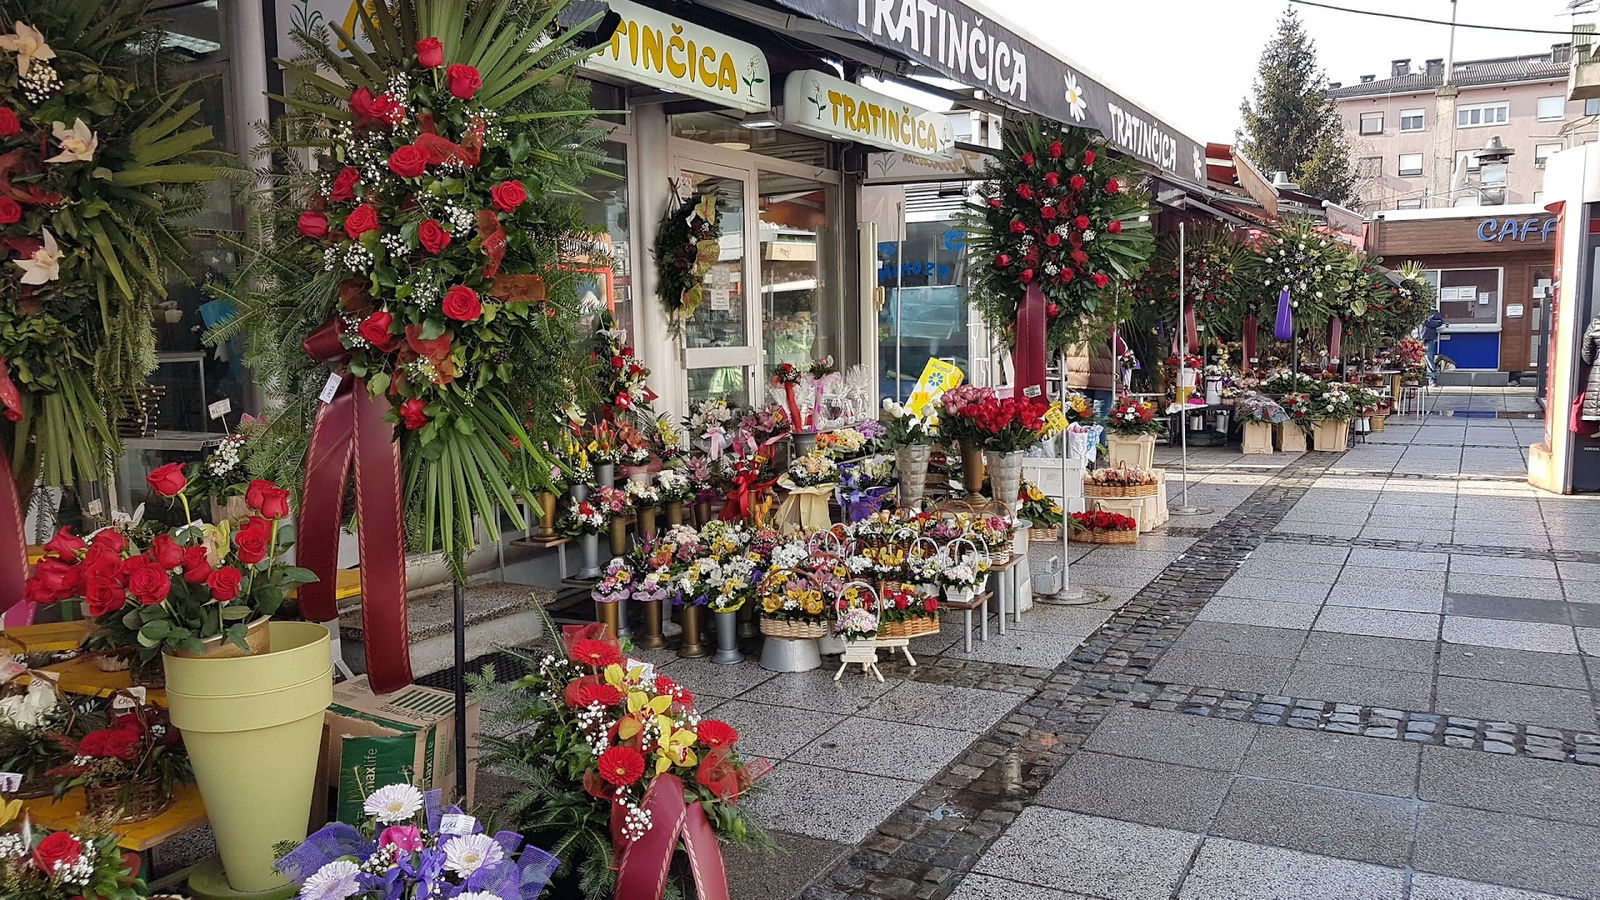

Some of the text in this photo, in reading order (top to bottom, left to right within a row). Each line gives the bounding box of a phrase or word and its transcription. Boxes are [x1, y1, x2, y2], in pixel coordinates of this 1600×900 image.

[597, 19, 738, 95] TINČICA
[827, 89, 938, 153] TRATINČICA
[1108, 102, 1177, 171] TRATINČICA
